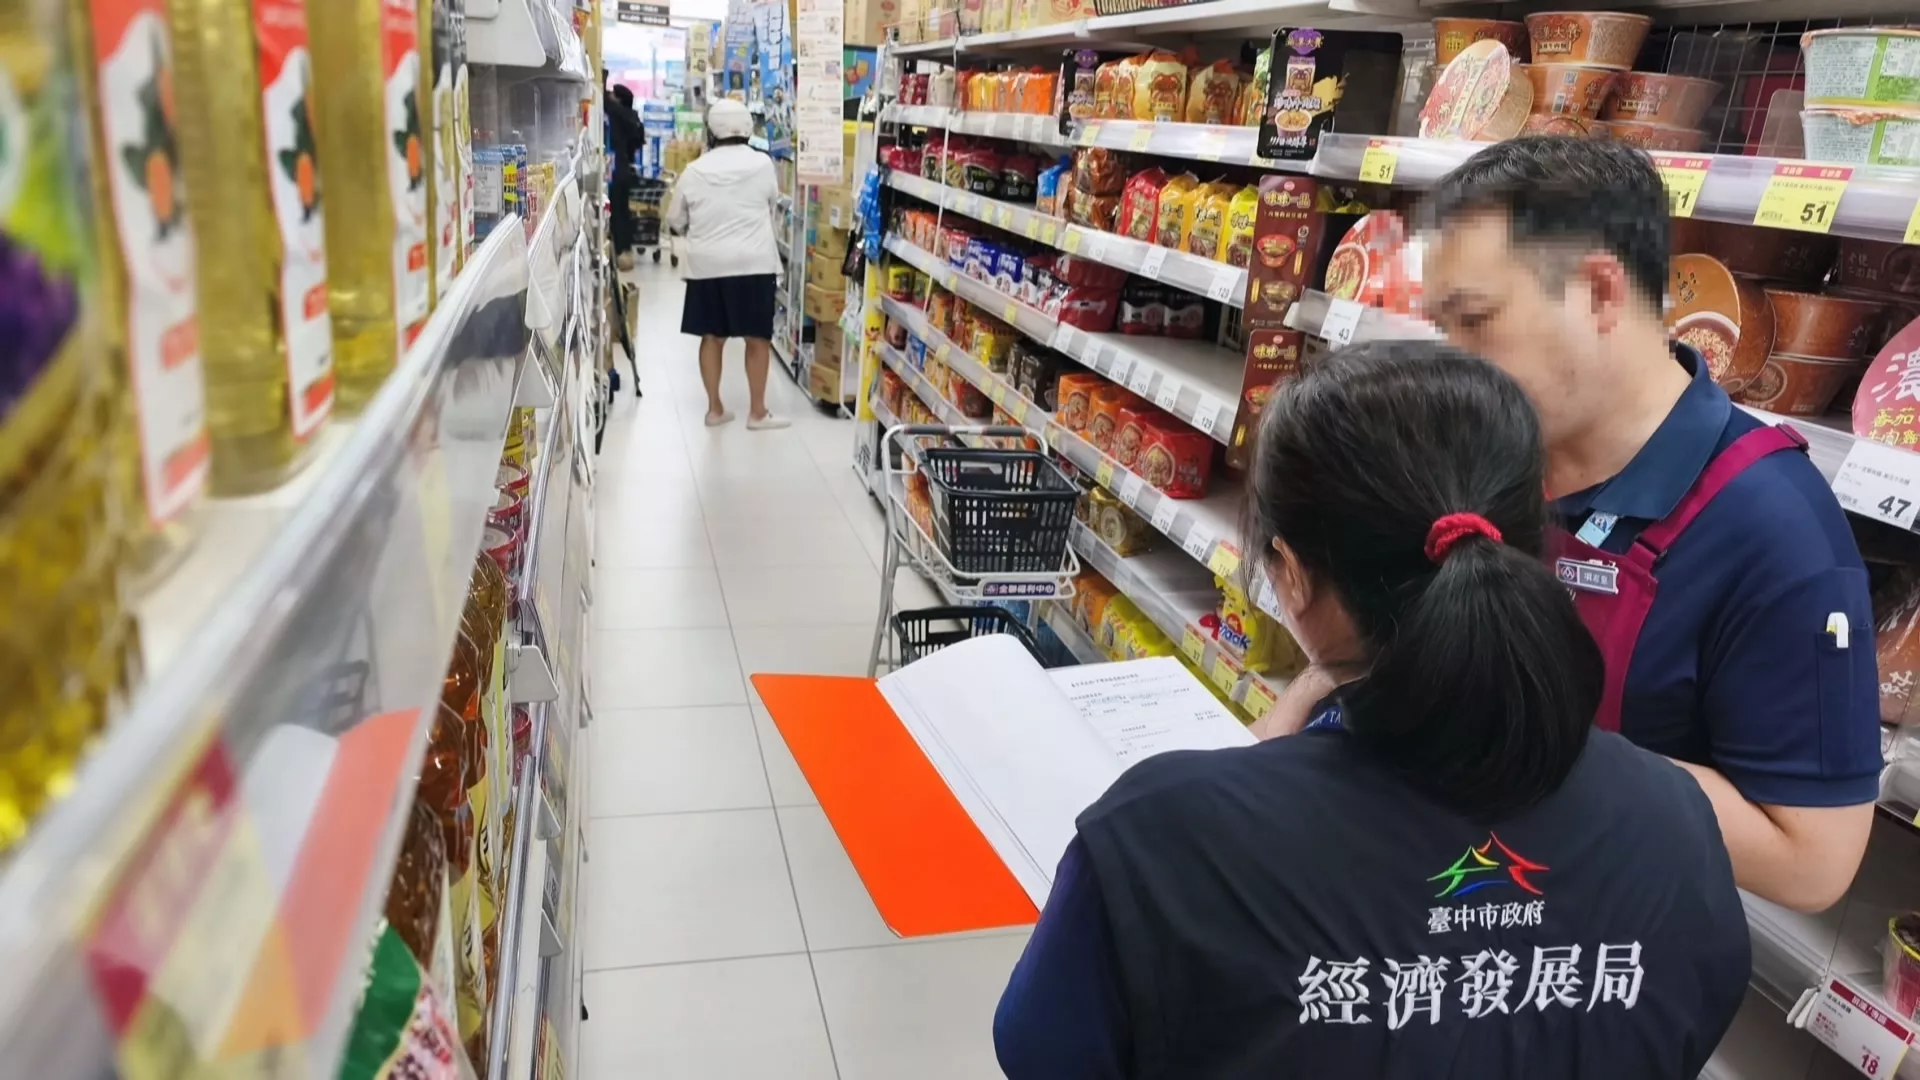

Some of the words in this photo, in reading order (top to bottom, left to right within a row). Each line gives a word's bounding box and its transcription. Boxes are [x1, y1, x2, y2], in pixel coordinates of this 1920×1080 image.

[1379, 164, 1392, 179] 51
[1799, 202, 1827, 224] 51
[1338, 327, 1350, 341] 43
[1877, 495, 1912, 519] 47
[1427, 899, 1546, 934] 臺中市政府
[1297, 940, 1645, 1031] 經濟發展局
[1861, 1053, 1879, 1076] 18
